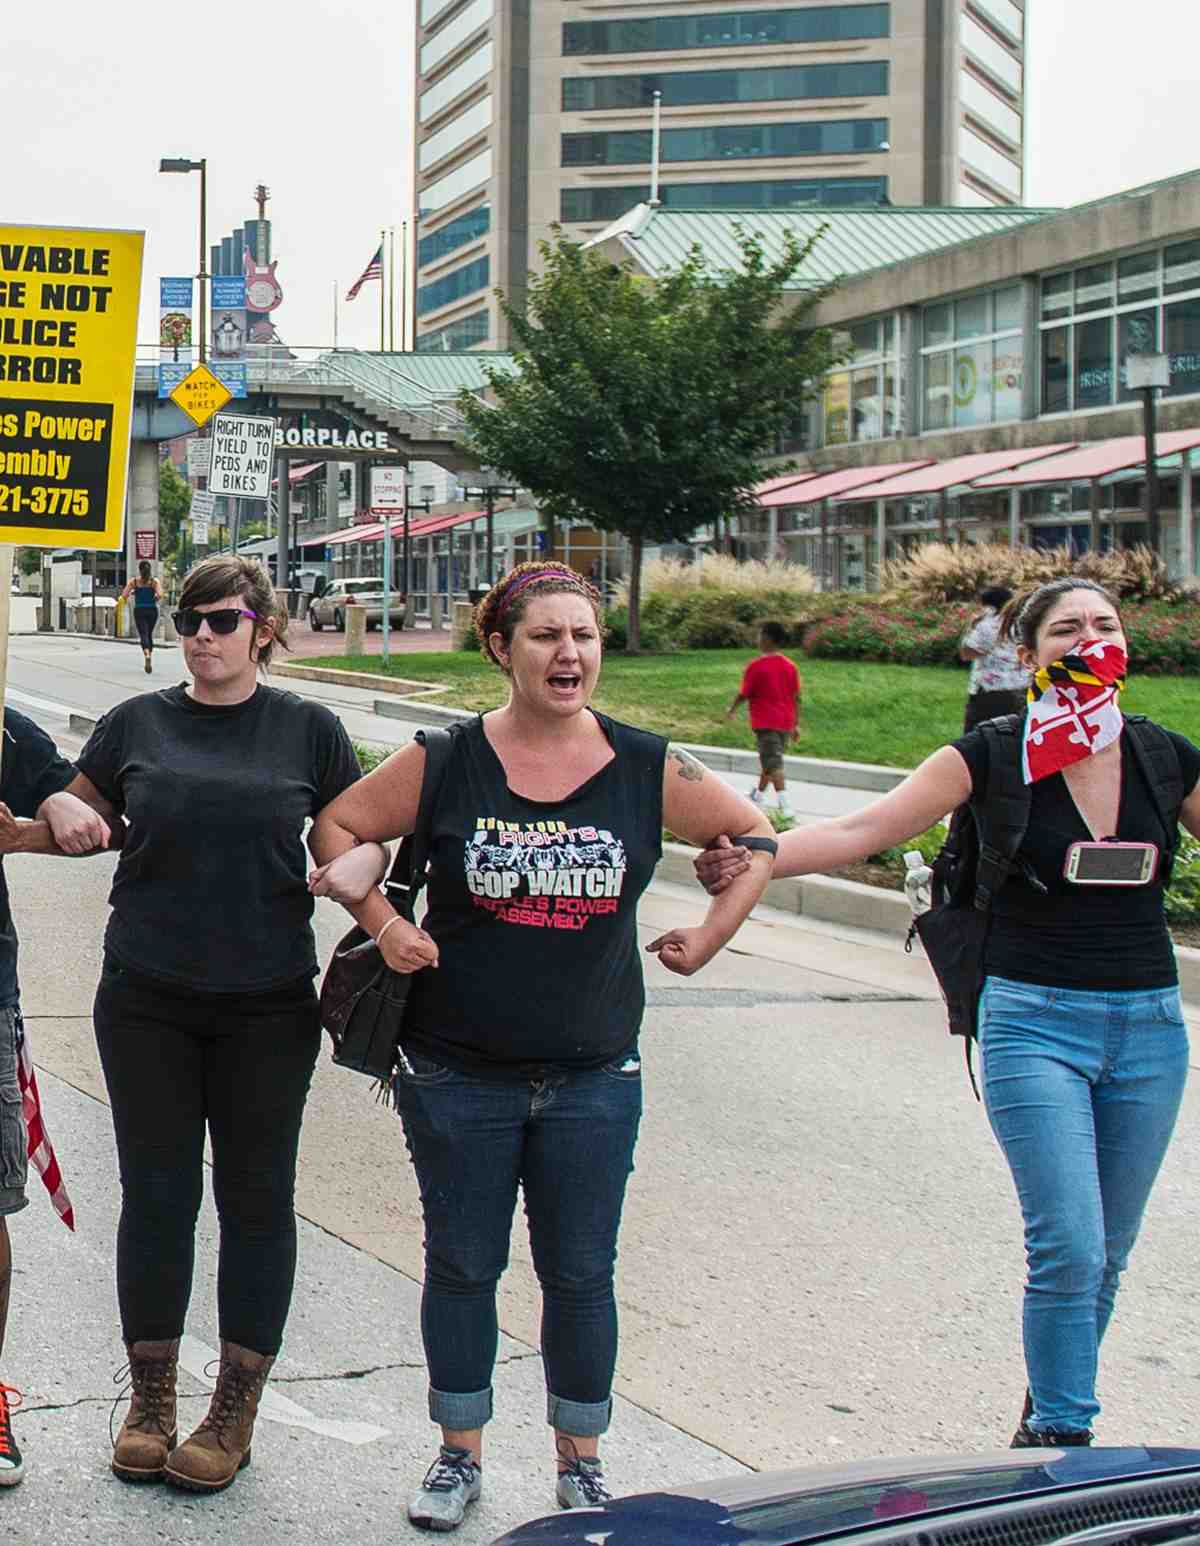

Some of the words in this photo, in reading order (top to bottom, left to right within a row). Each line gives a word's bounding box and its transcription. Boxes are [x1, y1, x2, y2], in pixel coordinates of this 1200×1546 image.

[40, 284, 112, 312] NOT
[24, 411, 106, 442] Power
[216, 420, 244, 436] RIGHT
[247, 422, 272, 439] TURN
[216, 438, 248, 455] YIELD
[256, 441, 270, 457] TO
[214, 455, 241, 472] PEDS
[246, 459, 268, 475] AND
[222, 474, 257, 491] BIKES
[499, 826, 599, 847] RIGHTS
[466, 869, 520, 899] COP
[527, 867, 625, 898] WATCH
[555, 898, 618, 914] POWER
[496, 908, 590, 930] ASSEMBLY
